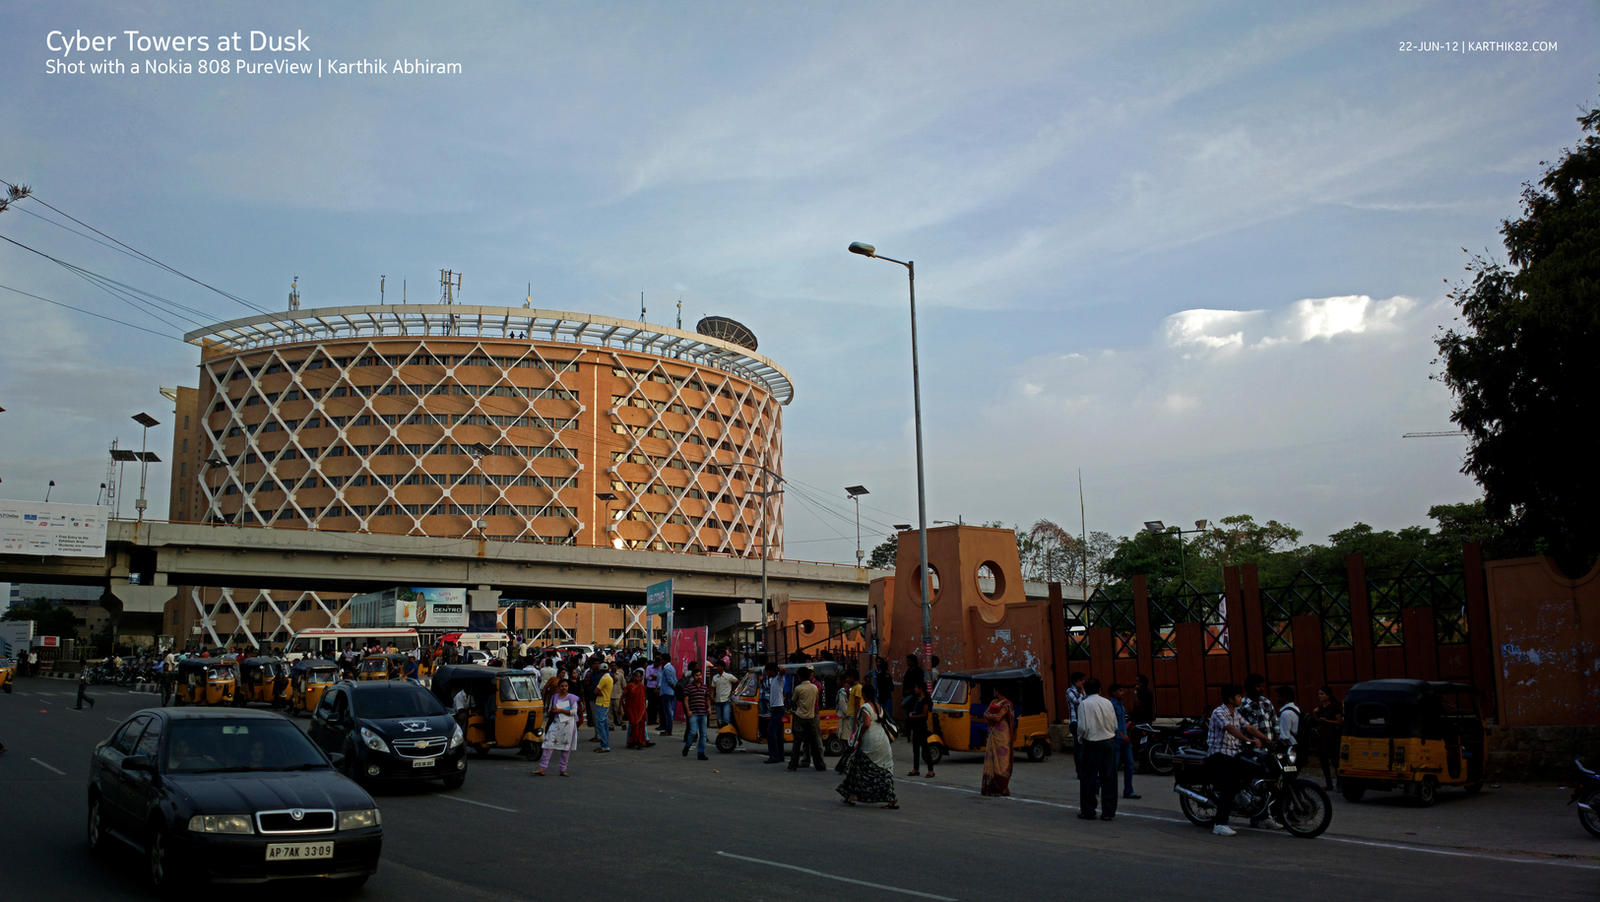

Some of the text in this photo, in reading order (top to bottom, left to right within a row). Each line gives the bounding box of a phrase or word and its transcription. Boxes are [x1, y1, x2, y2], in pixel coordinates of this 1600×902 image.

[269, 845, 331, 857] AP 7AK 3309
